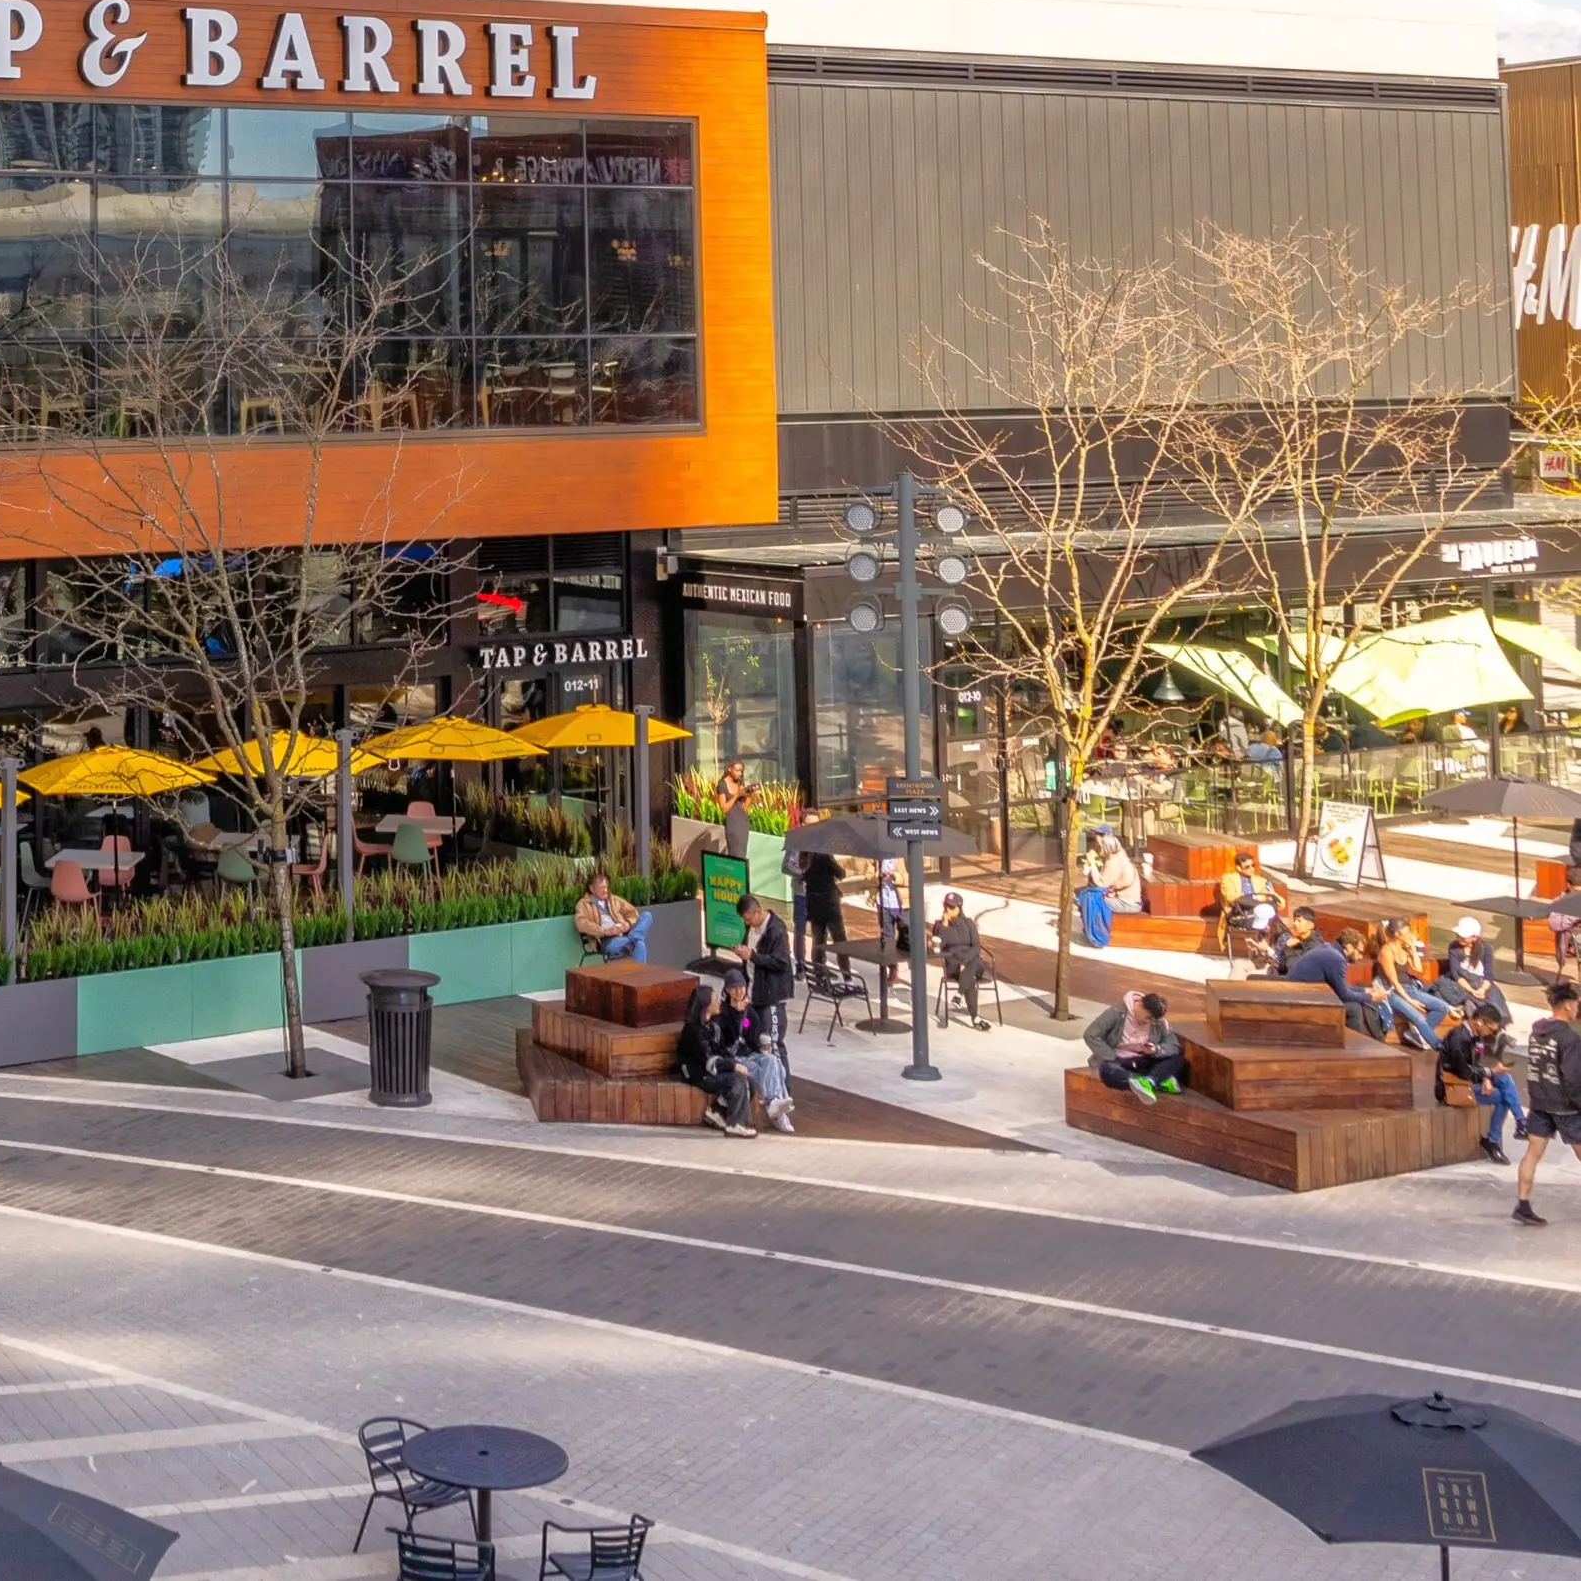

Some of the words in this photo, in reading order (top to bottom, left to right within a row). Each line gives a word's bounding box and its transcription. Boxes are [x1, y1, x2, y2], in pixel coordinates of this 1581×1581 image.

[180, 7, 597, 100] BARREL
[682, 582, 728, 601] AUTHENTIC
[730, 587, 766, 605] MEXICAN
[768, 591, 792, 607] FOOD
[479, 646, 526, 669] TAP
[533, 643, 548, 667] &
[553, 638, 649, 664] BARREL
[563, 678, 600, 692] 012-11
[709, 874, 743, 892] HAPPY
